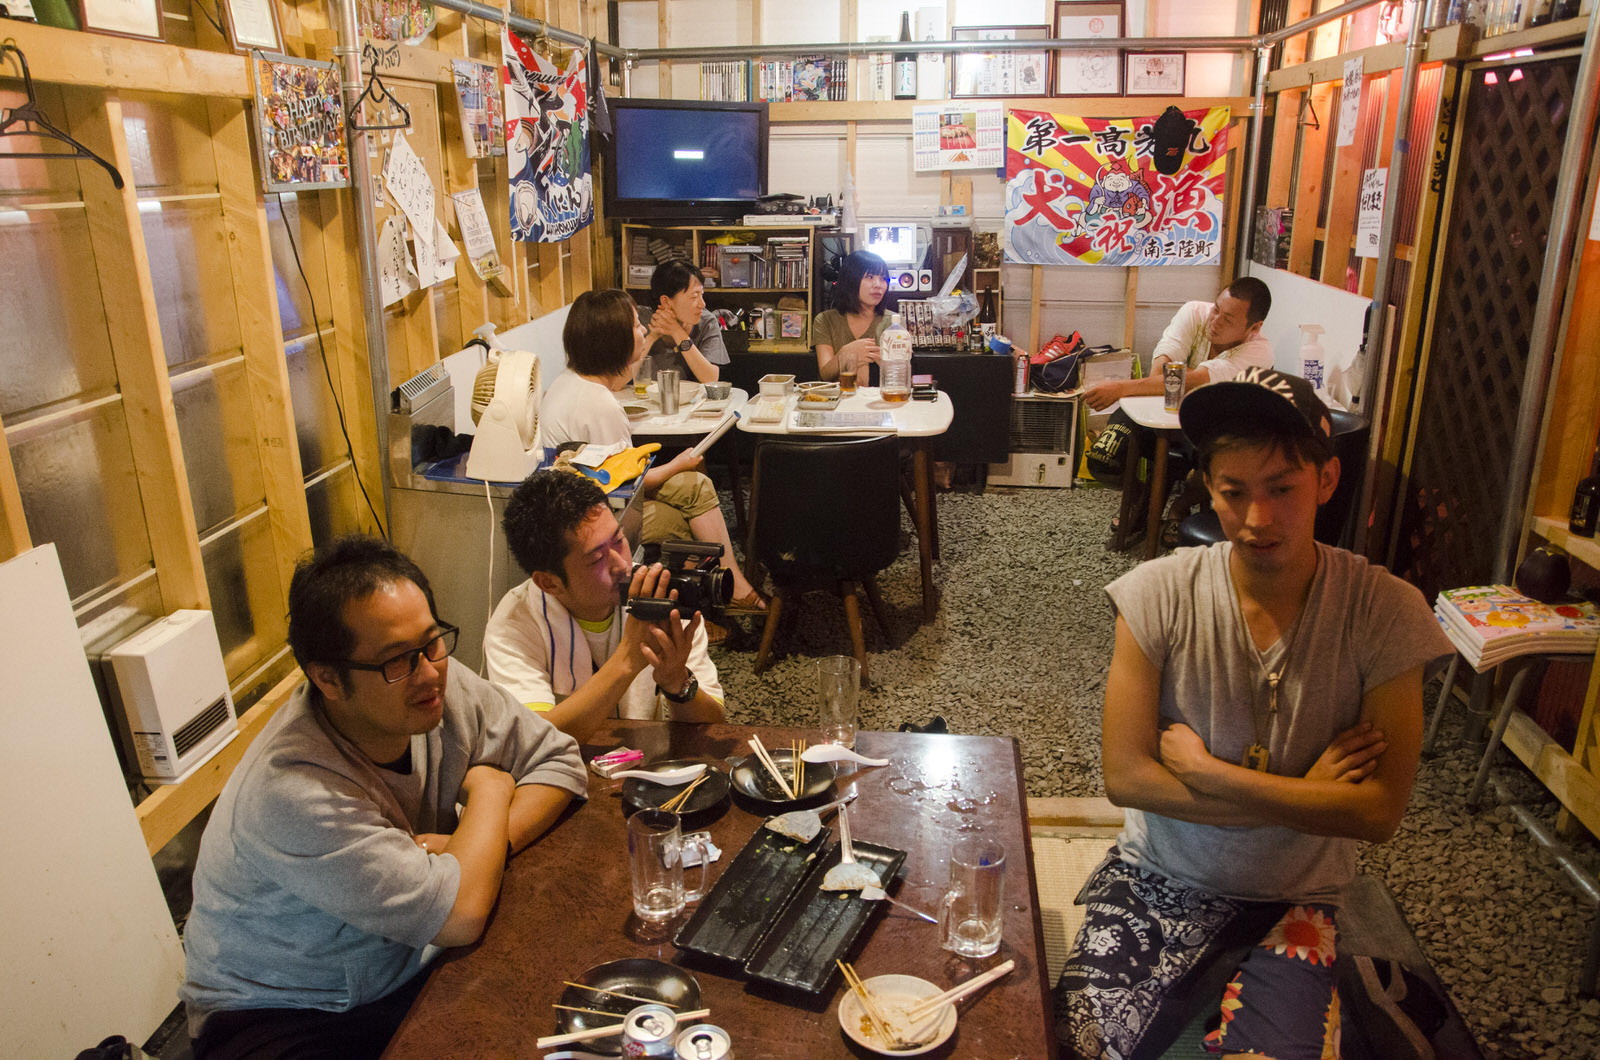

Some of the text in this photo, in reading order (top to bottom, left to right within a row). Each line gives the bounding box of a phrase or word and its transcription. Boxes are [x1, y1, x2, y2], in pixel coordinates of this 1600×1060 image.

[286, 94, 325, 120] HAPPY
[278, 113, 338, 149] BIRTHDAY
[1153, 172, 1212, 232] 漁
[1096, 214, 1135, 254] 祝
[1143, 239, 1214, 259] 南三陸町
[1122, 911, 1150, 944] PEACE
